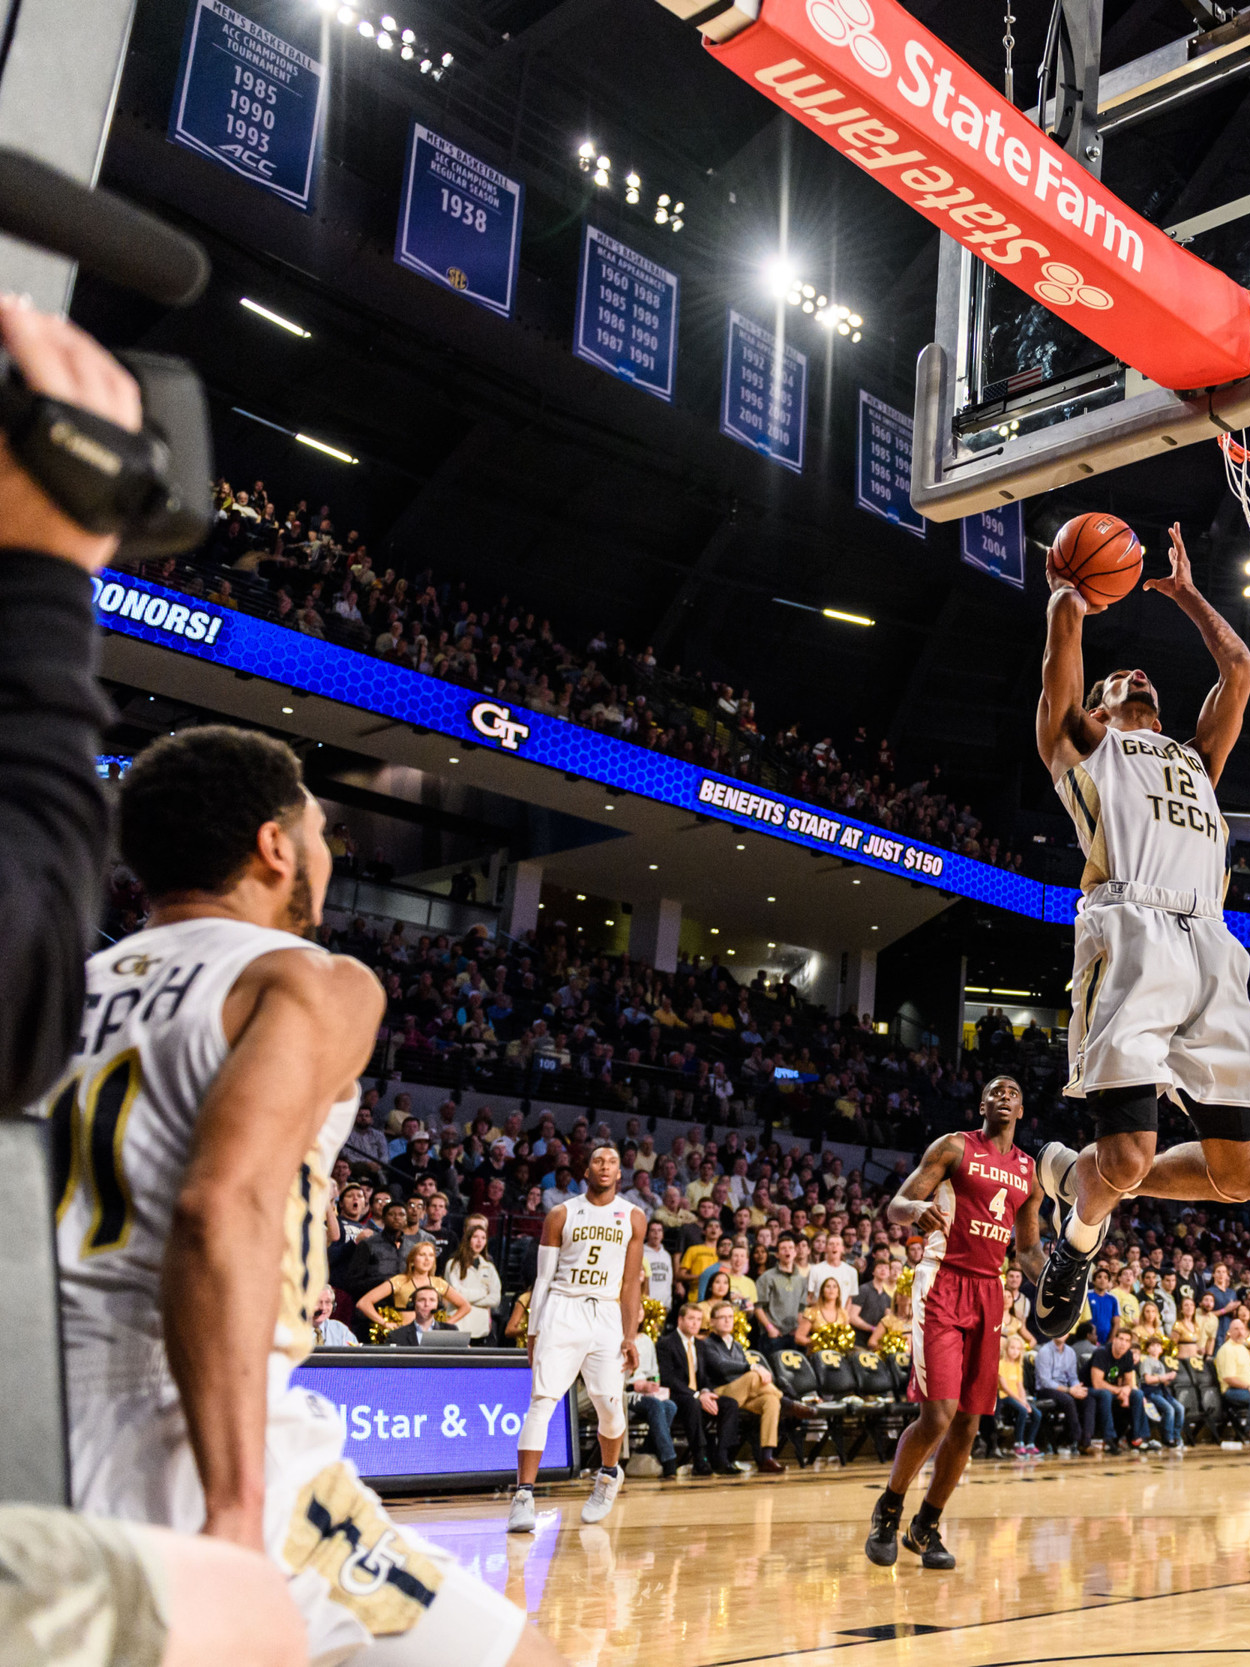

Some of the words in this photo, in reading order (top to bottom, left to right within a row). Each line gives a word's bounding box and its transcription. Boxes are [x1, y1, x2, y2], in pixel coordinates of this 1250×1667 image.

[212, 1, 246, 28] MEN'S
[250, 23, 312, 70] BASKETBALL
[222, 24, 240, 41] ACC
[243, 36, 298, 76] CHAMPIONS
[227, 38, 292, 83] TOURNAMENT
[234, 65, 277, 105] 1985
[230, 89, 275, 130] 1990
[227, 114, 269, 153] 1993
[218, 143, 277, 176] ACC
[435, 152, 448, 167] SEC
[451, 160, 498, 195] CHAMPIONS
[456, 150, 508, 188] BASKETBALL
[430, 160, 466, 188] REGULAR
[469, 183, 499, 208] SEASON
[441, 188, 487, 233] 1938
[449, 267, 467, 290] SEC
[601, 264, 629, 290] 1960
[634, 283, 660, 309] 1988
[600, 285, 626, 311] 1985
[633, 304, 659, 330] 1989
[598, 306, 625, 332] 1986
[631, 324, 658, 351] 1990
[597, 327, 623, 352] 1987
[630, 346, 655, 371] 1991
[742, 347, 764, 371] 1992
[741, 366, 764, 390] 1993
[740, 386, 763, 410] 1996
[739, 407, 762, 430] 2001
[871, 422, 891, 444] 1960
[871, 442, 891, 462] 1985
[871, 460, 891, 482] 1986
[871, 480, 891, 501] 1990
[981, 513, 1004, 536] 1990
[982, 535, 1007, 560] 2004
[470, 702, 528, 750] GT
[1164, 766, 1198, 800] 12
[699, 779, 786, 825] BENEFITS
[787, 807, 841, 841] START
[840, 827, 864, 849] AT
[863, 835, 905, 864] JUST
[904, 846, 943, 877] $150
[1147, 794, 1218, 842] TECH
[968, 1162, 1028, 1195] FLORIDA
[989, 1188, 1008, 1221] 4
[572, 1226, 624, 1246] GEORGIA
[969, 1220, 1011, 1244] STATE
[587, 1246, 602, 1265] 5
[570, 1268, 608, 1287] TECH
[441, 1403, 467, 1438] &
[479, 1403, 526, 1436] Yo
